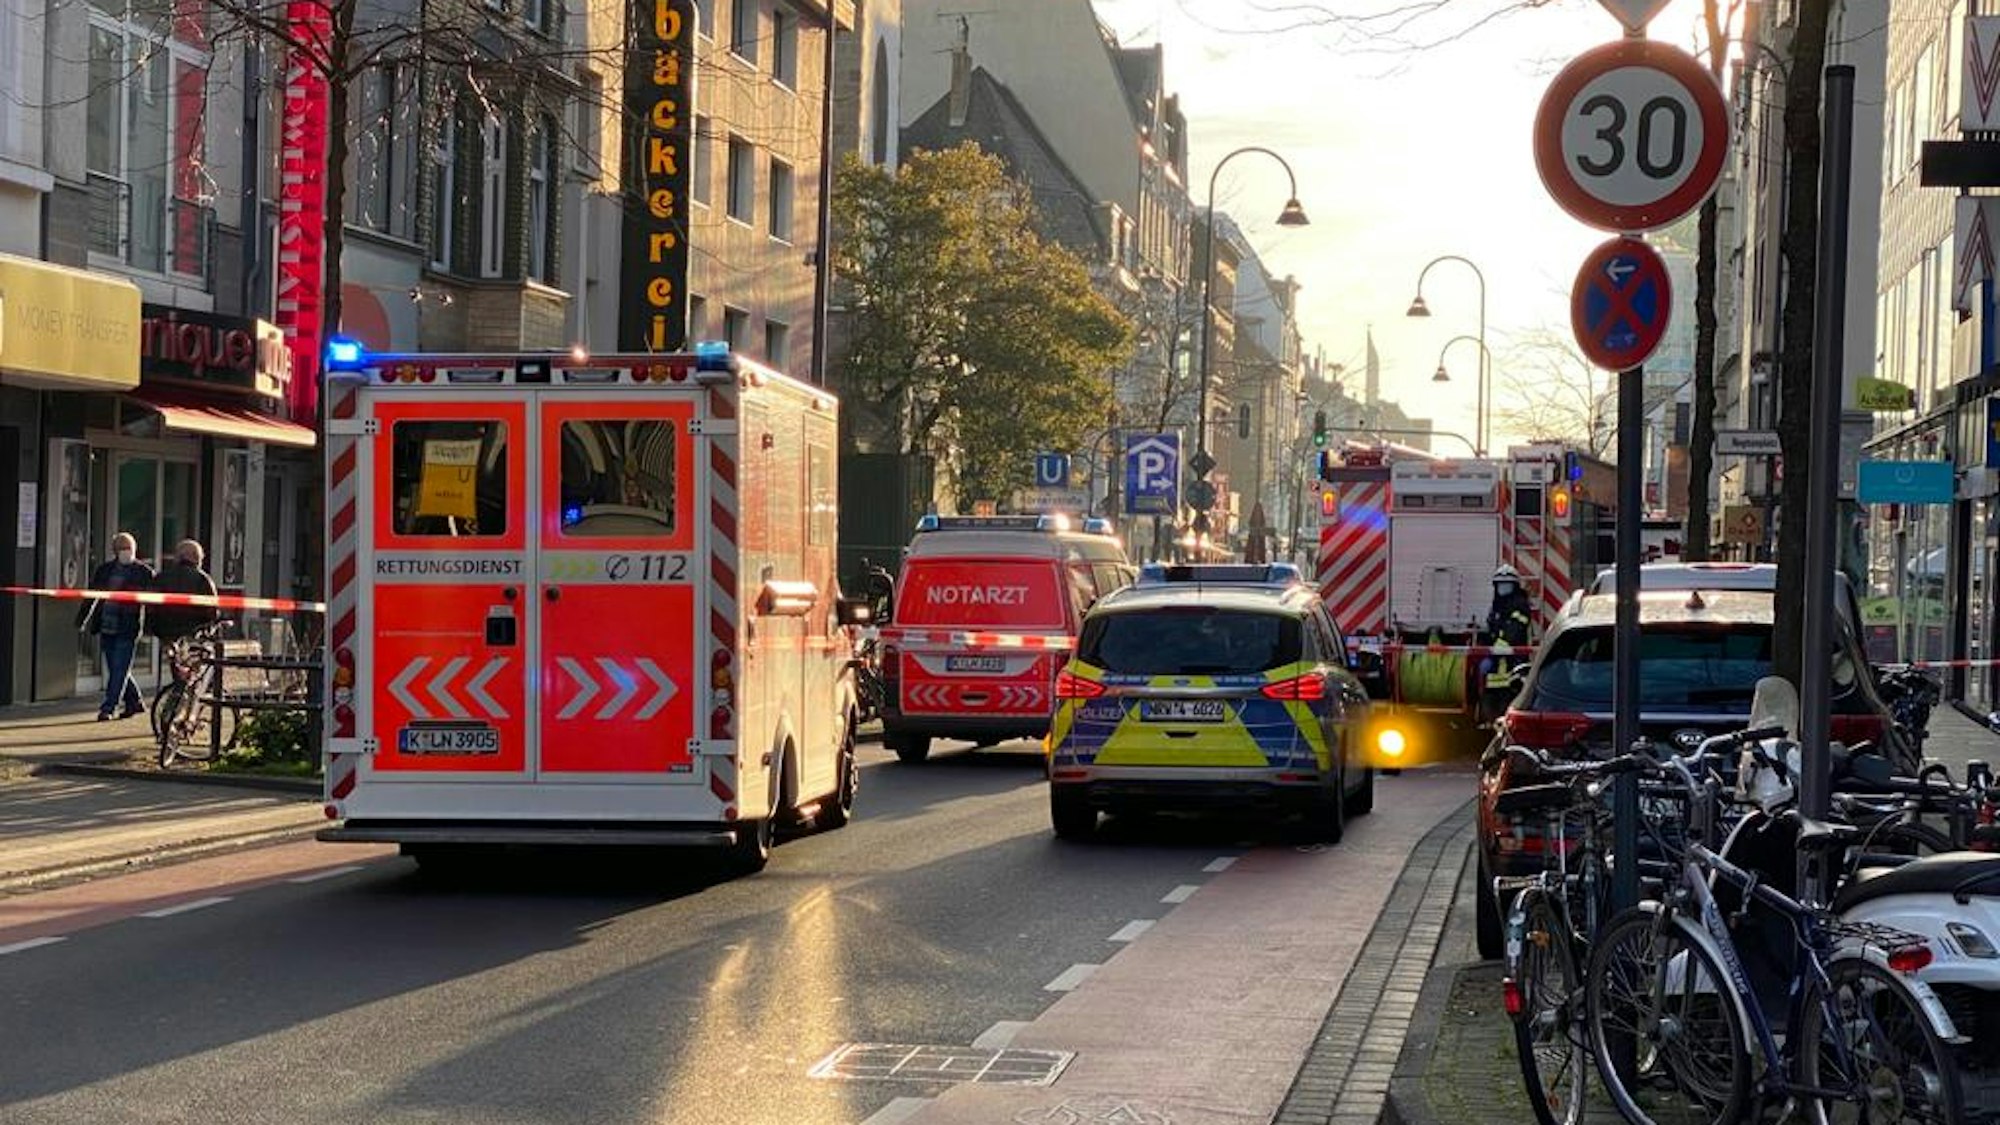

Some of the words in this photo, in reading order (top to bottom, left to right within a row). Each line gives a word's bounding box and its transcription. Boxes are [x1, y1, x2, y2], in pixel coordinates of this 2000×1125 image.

[1577, 94, 1687, 179] 30
[648, 0, 681, 350] bäckerei
[18, 304, 63, 338] MONEY
[69, 311, 129, 343] TRANSFER
[1042, 459, 1062, 483] U
[1138, 452, 1165, 490] P
[376, 559, 522, 574] RETTUNGSDIENST
[640, 555, 687, 580] 112
[927, 585, 1029, 604] NOTARZT
[409, 732, 420, 748] K
[431, 732, 452, 748] LN
[456, 732, 495, 748] 3905
